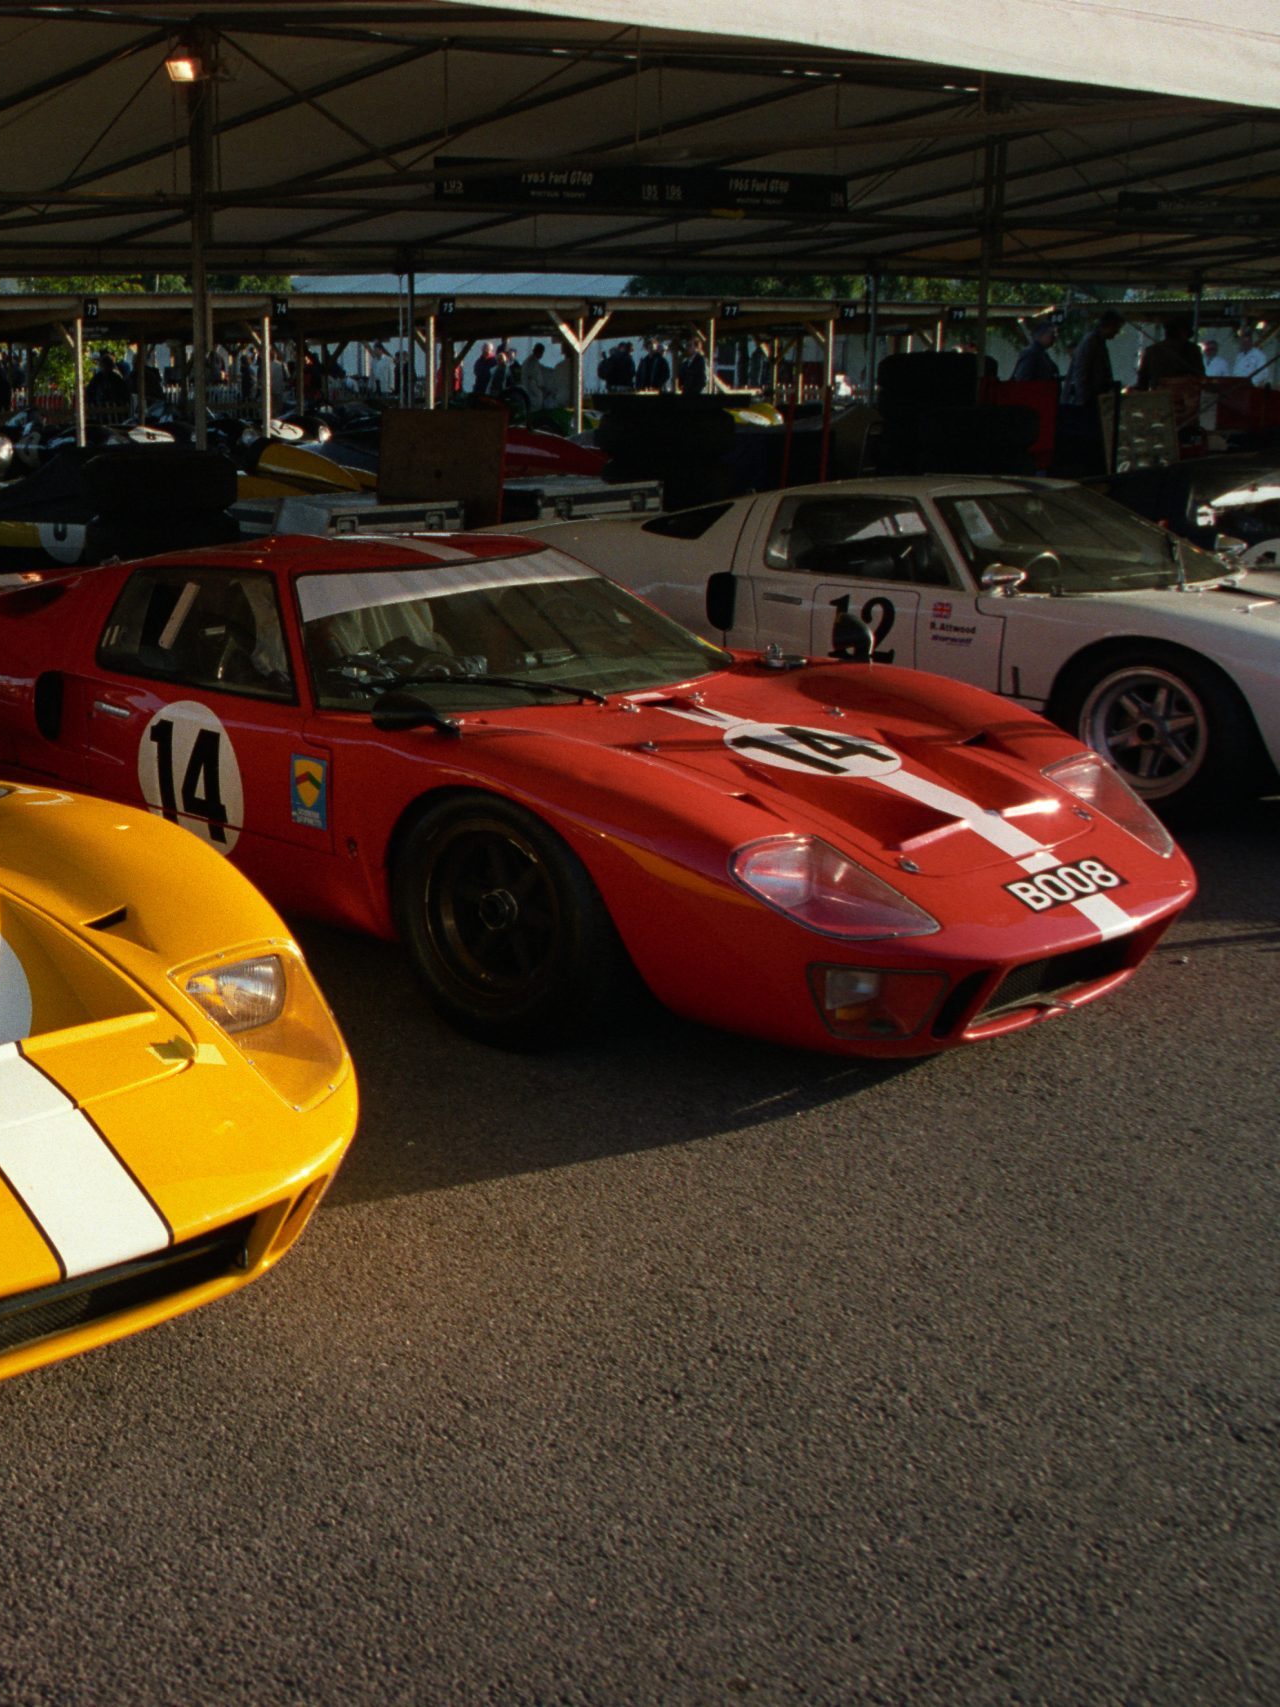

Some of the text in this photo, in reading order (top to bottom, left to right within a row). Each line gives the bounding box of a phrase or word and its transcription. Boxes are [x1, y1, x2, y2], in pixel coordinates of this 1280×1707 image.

[548, 171, 569, 185] Ford
[570, 171, 594, 186] GT40
[751, 178, 768, 193] Ford
[768, 179, 790, 193] GT40
[87, 304, 97, 316] 73
[276, 303, 287, 314] 74
[443, 302, 454, 313] 75
[592, 304, 603, 315] 76
[724, 306, 737, 317] 77
[952, 309, 963, 320] 79
[827, 594, 895, 663] 12
[939, 623, 977, 634] Attwood
[730, 726, 897, 774] 14
[149, 718, 229, 845] 14
